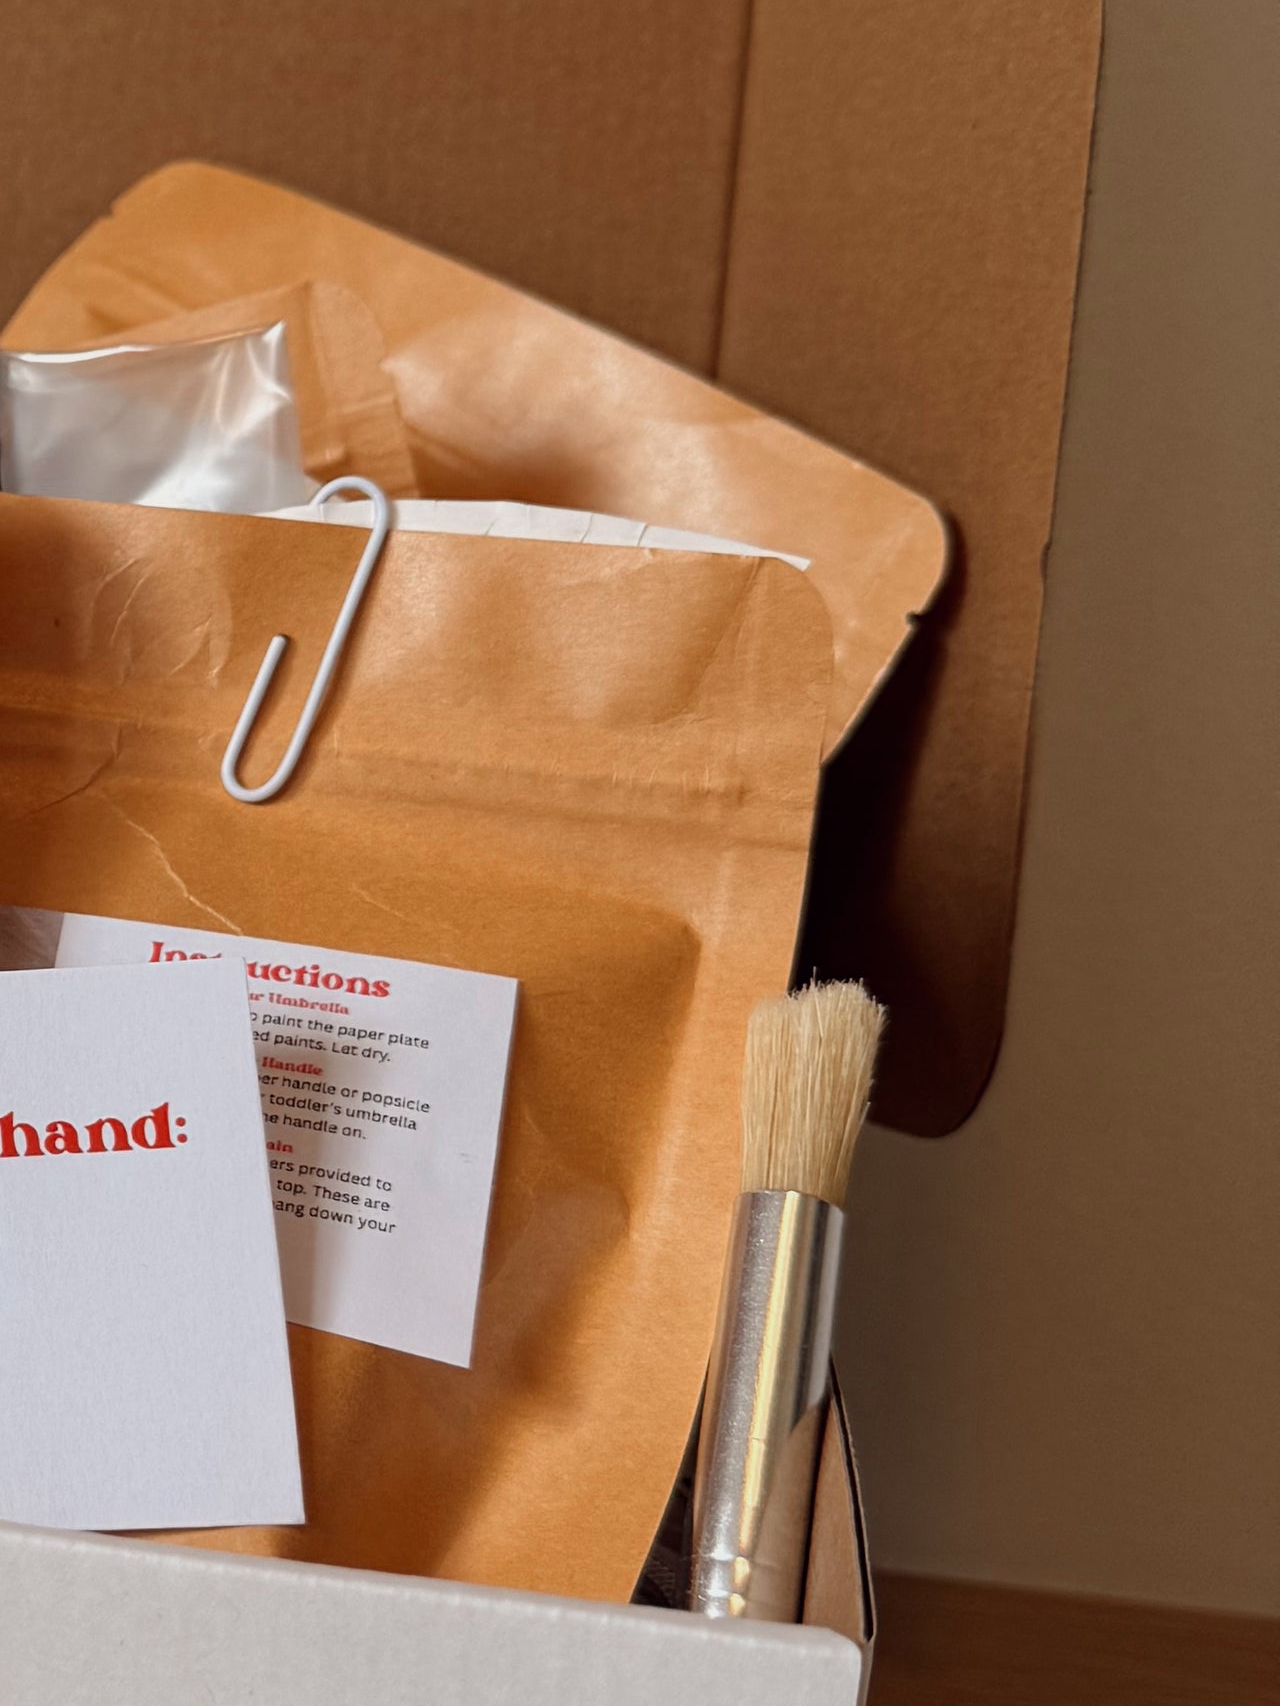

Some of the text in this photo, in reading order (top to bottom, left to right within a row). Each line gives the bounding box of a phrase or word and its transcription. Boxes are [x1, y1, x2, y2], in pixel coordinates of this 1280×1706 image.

[262, 1012, 303, 1030] paint
[307, 1019, 333, 1033] the
[338, 1024, 385, 1042] paper
[388, 1032, 430, 1049] plate
[274, 1031, 327, 1051] paints.
[361, 1046, 391, 1063] dry.
[281, 1075, 336, 1096] handle
[340, 1086, 359, 1099] or
[362, 1090, 430, 1113] popsicle
[282, 1112, 338, 1133] handle
[345, 1107, 417, 1131] umbrella
[298, 1162, 371, 1187] provided
[375, 1178, 392, 1192] to
[276, 1179, 391, 1212] top. These are
[309, 1206, 354, 1224] down
[358, 1216, 397, 1234] your
